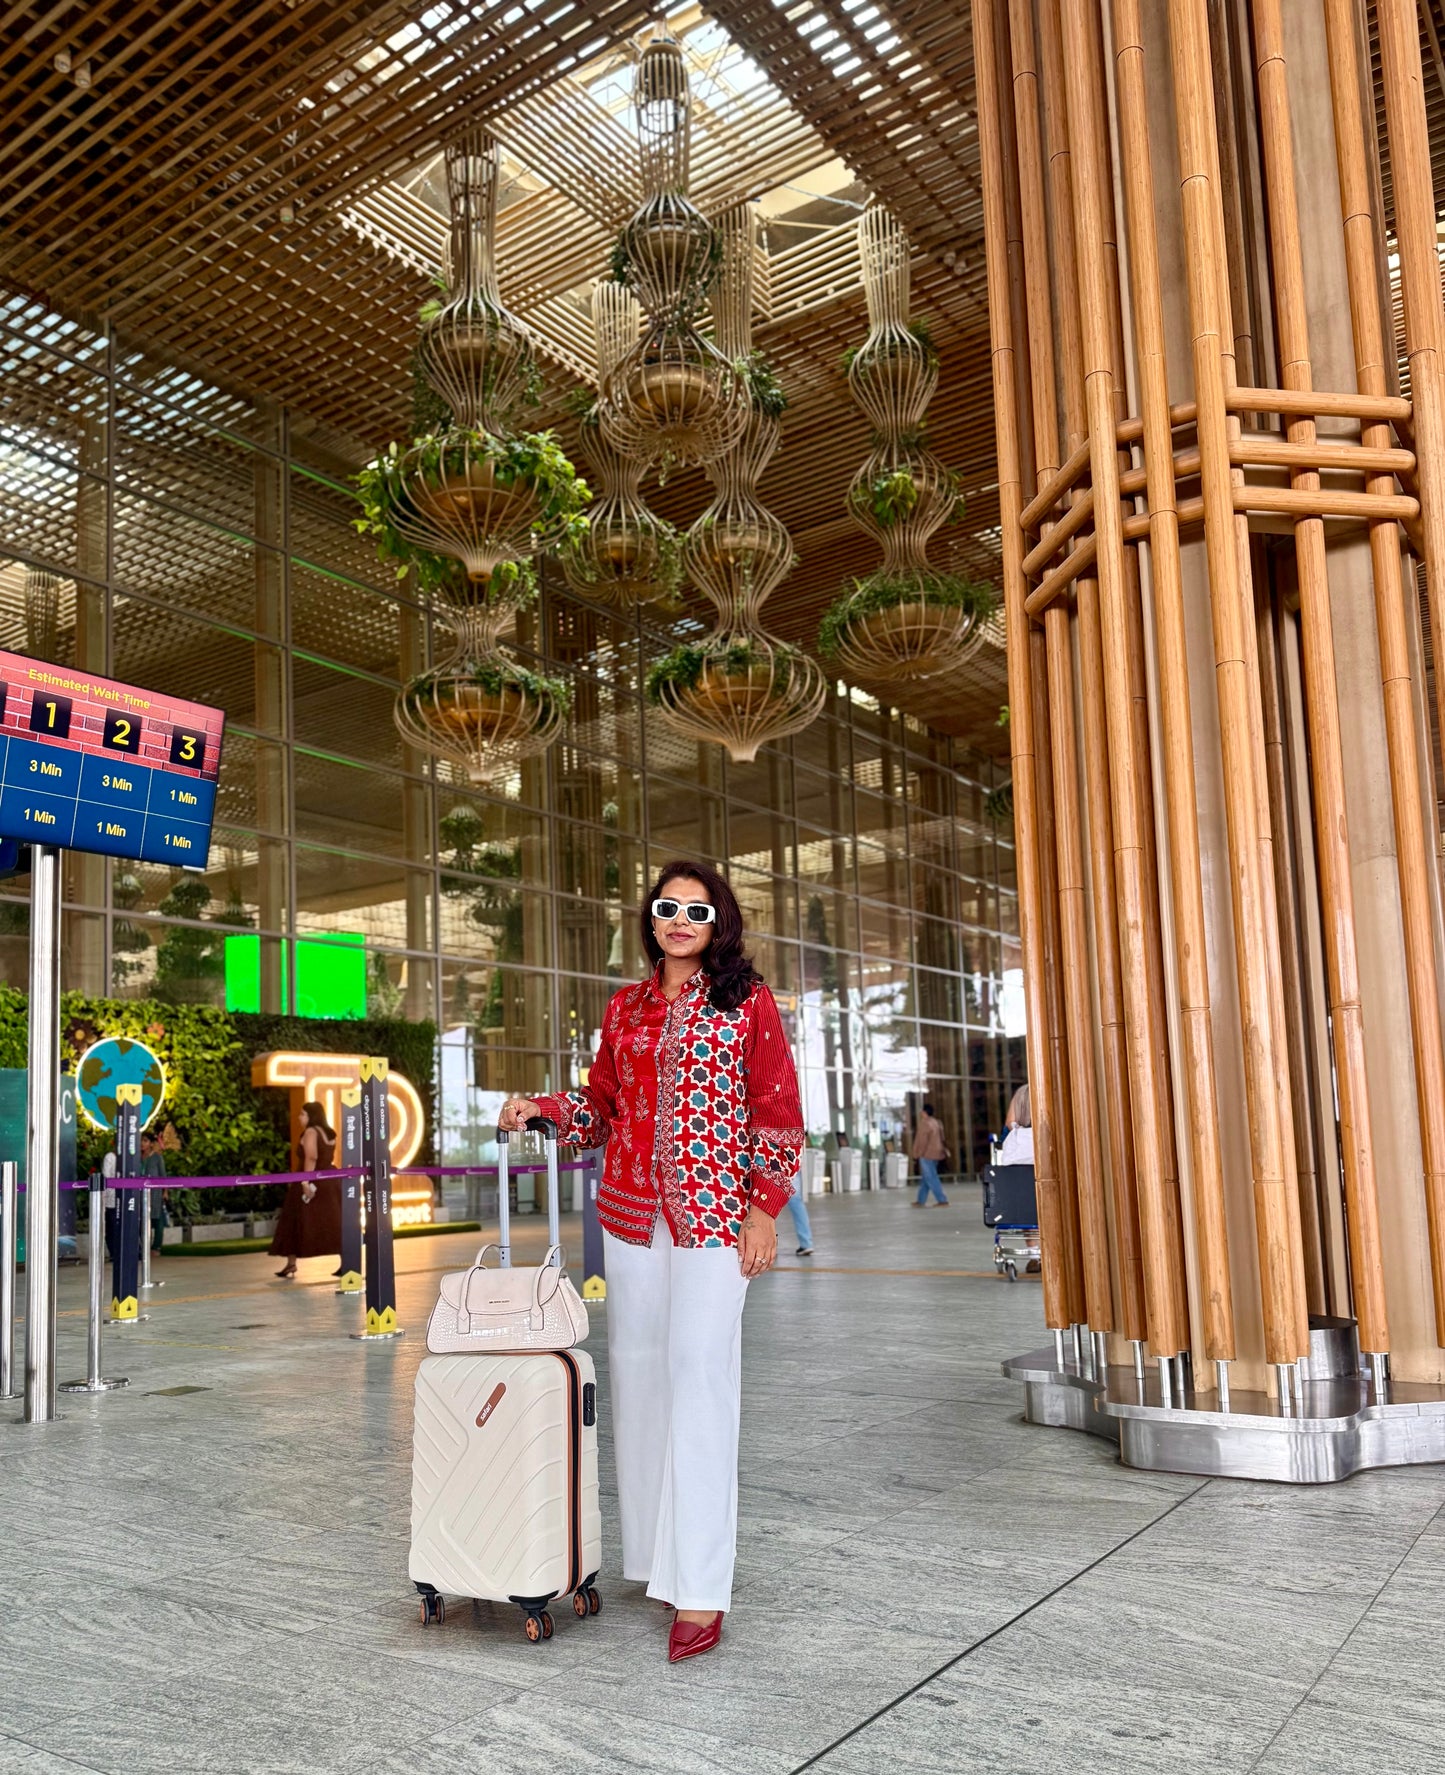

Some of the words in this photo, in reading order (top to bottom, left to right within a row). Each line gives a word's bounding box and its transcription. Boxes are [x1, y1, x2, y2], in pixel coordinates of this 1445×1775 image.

[28, 668, 90, 694] Estimated
[93, 686, 120, 702] Wait
[123, 693, 151, 710] Time
[46, 702, 57, 728] 1
[112, 719, 131, 746] 2
[179, 735, 197, 760] 3
[29, 760, 38, 772] 3
[40, 763, 62, 777] Min
[102, 775, 111, 787] 3
[113, 778, 133, 792] Min
[170, 789, 176, 800] 1
[178, 793, 197, 805] Min
[24, 808, 30, 820] 1
[34, 810, 56, 825] Min
[96, 822, 103, 833] 1
[106, 824, 126, 837] Min
[164, 834, 170, 845] 1
[172, 837, 192, 849] Min
[479, 1402, 493, 1421] safari
